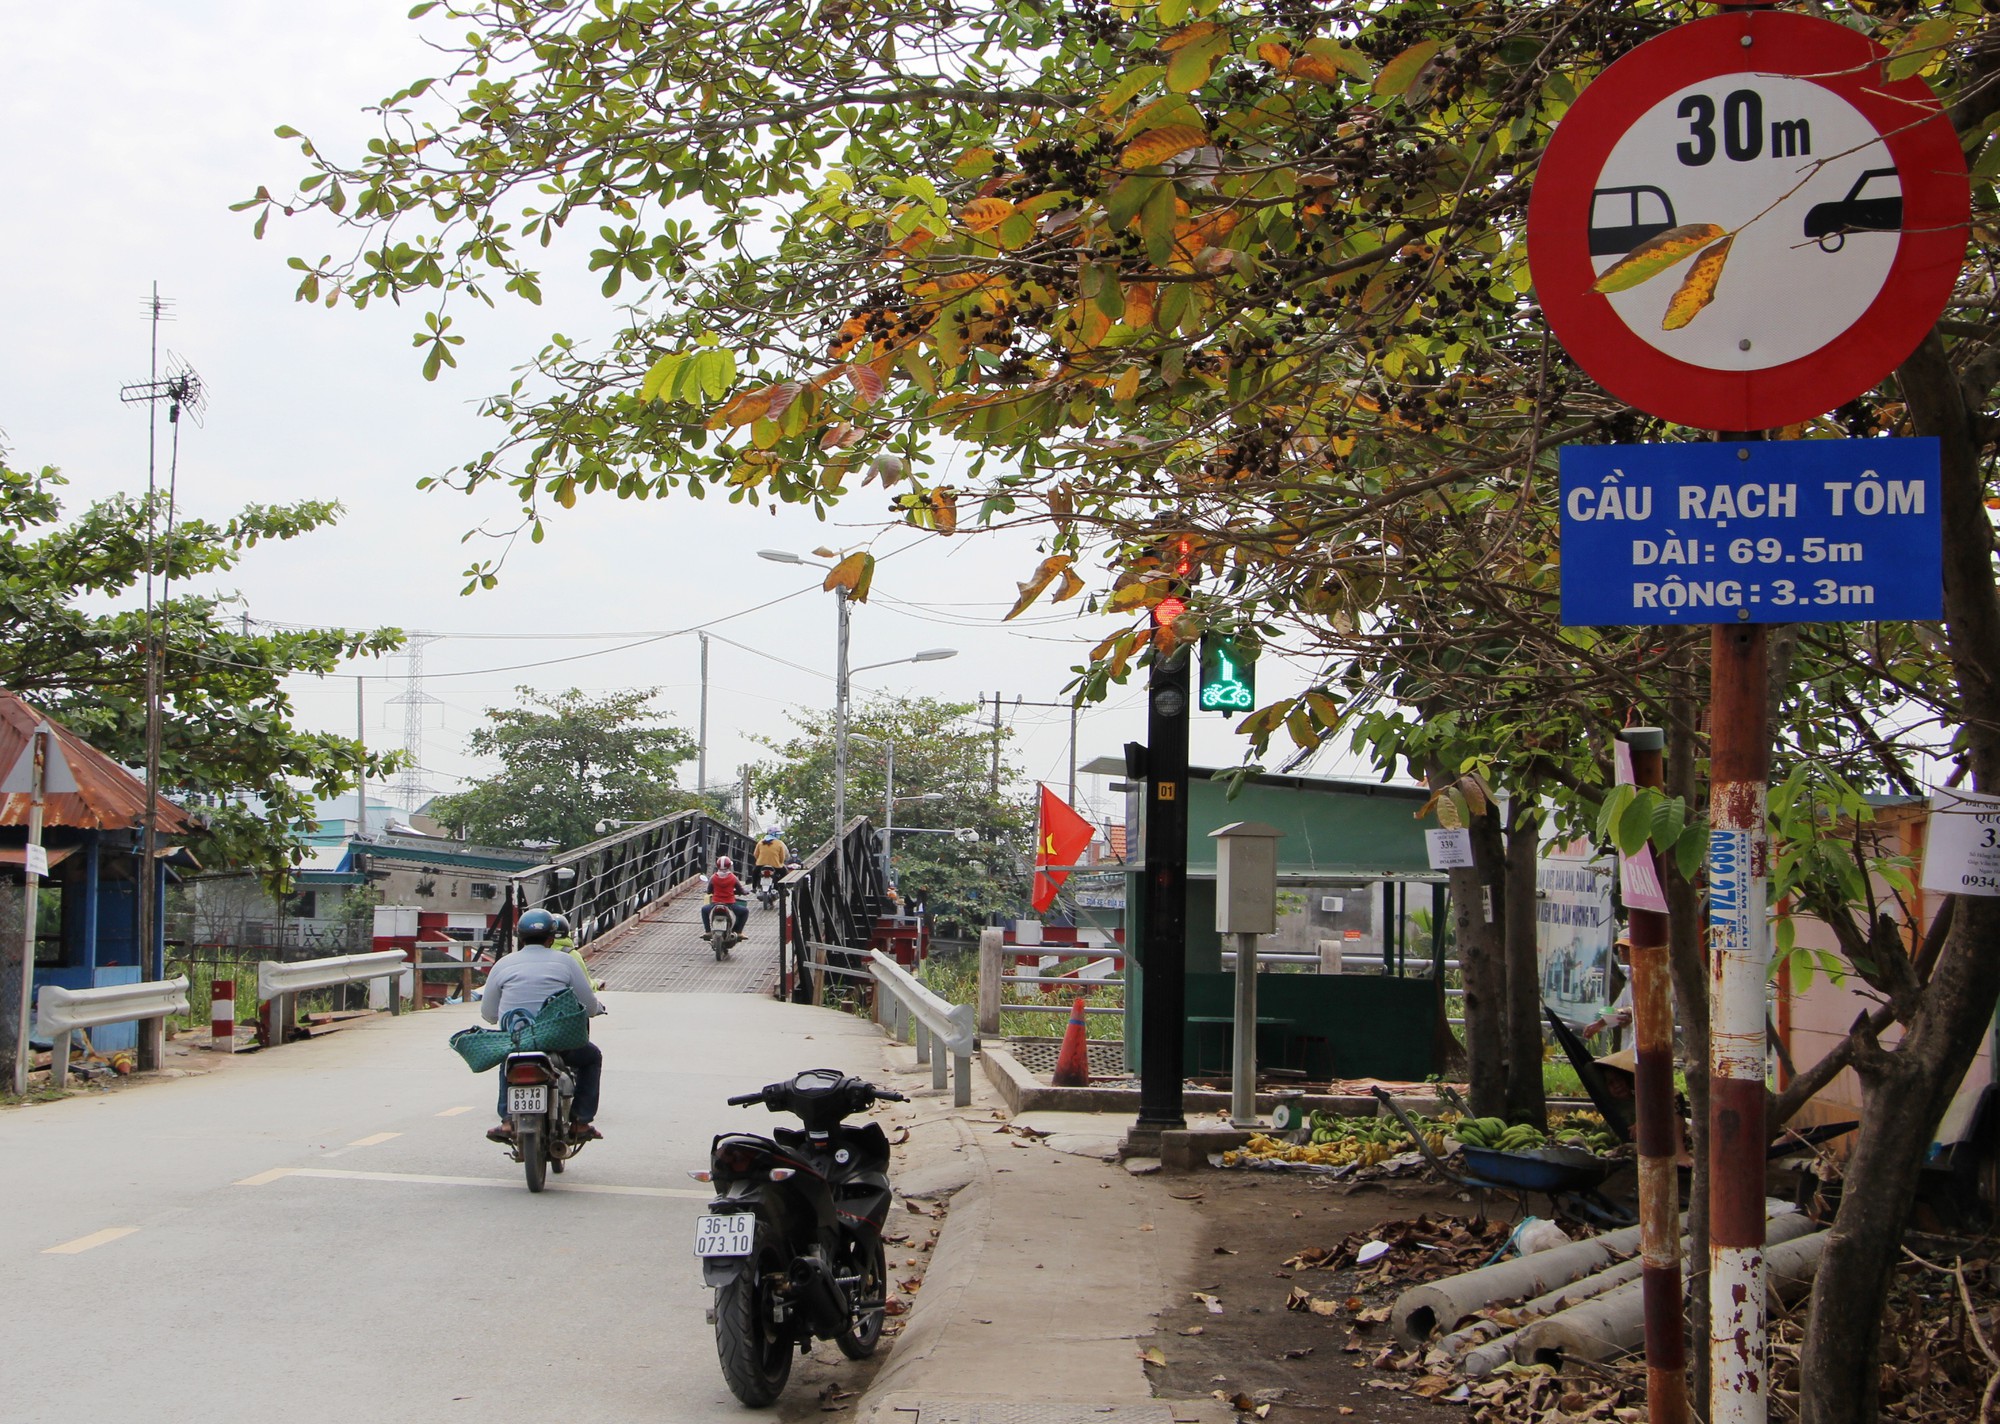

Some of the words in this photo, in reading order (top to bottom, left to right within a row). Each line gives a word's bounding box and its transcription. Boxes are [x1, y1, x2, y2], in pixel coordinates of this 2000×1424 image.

[1676, 88, 1811, 167] 30m
[1567, 469, 1652, 521] CẦU
[1679, 482, 1797, 528] RẠCH
[1824, 469, 1926, 518] TÔM
[1632, 530, 1716, 565] DÀI:
[1728, 537, 1863, 564] 69.5m
[1632, 576, 1761, 615] RỘNG:
[1771, 578, 1875, 605] 3.3m
[1161, 786, 1173, 797] 01
[514, 1100, 541, 1111] 8380
[705, 1217, 745, 1234] 36-L6
[698, 1236, 749, 1254] 073.10
